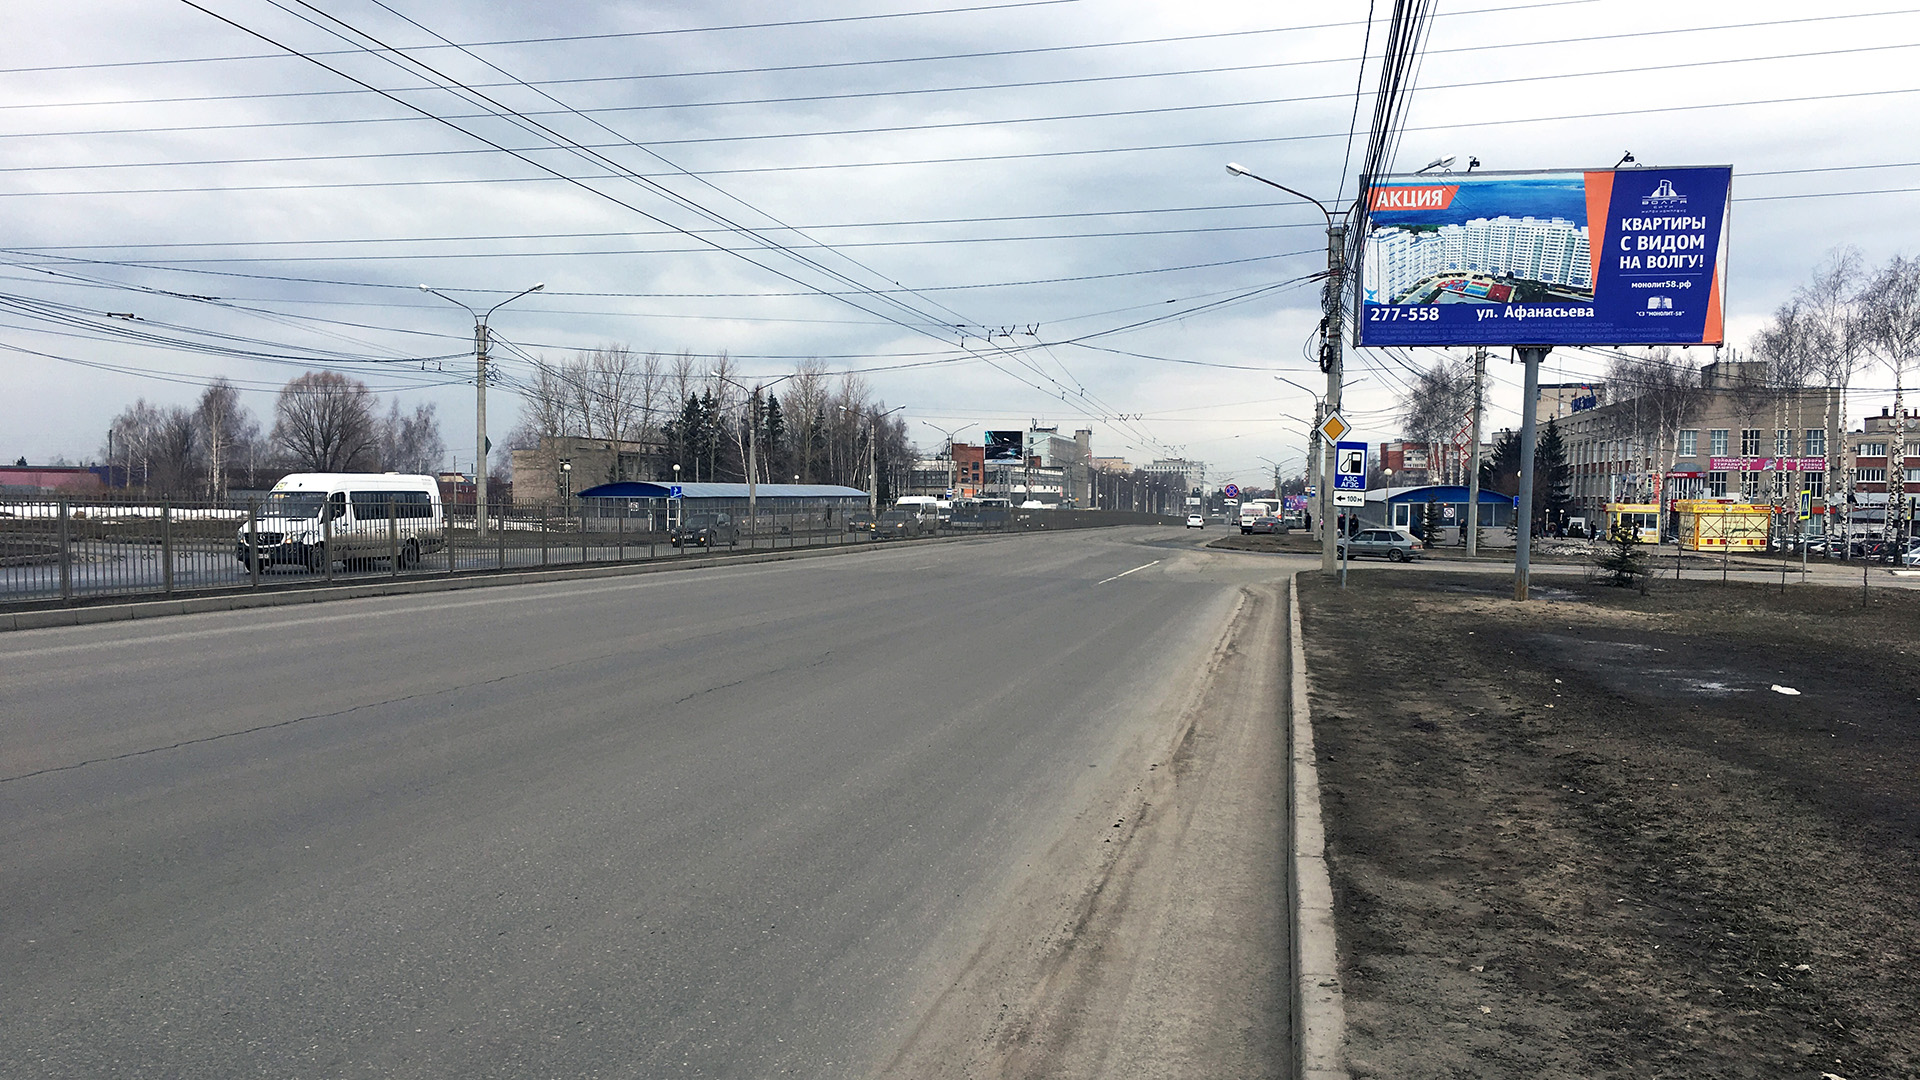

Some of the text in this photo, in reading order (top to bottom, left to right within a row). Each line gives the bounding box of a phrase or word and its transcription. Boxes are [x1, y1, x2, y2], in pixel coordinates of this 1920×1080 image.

[1621, 216, 1706, 231] КВАРТИРЫ
[1620, 234, 1705, 253] С ВИДОМ
[1619, 254, 1704, 269] НА ВОЛГУ!
[1631, 279, 1692, 290] монолит58.рф
[1370, 307, 1440, 321] 277-558
[1476, 305, 1595, 322] ул. Афанасьева
